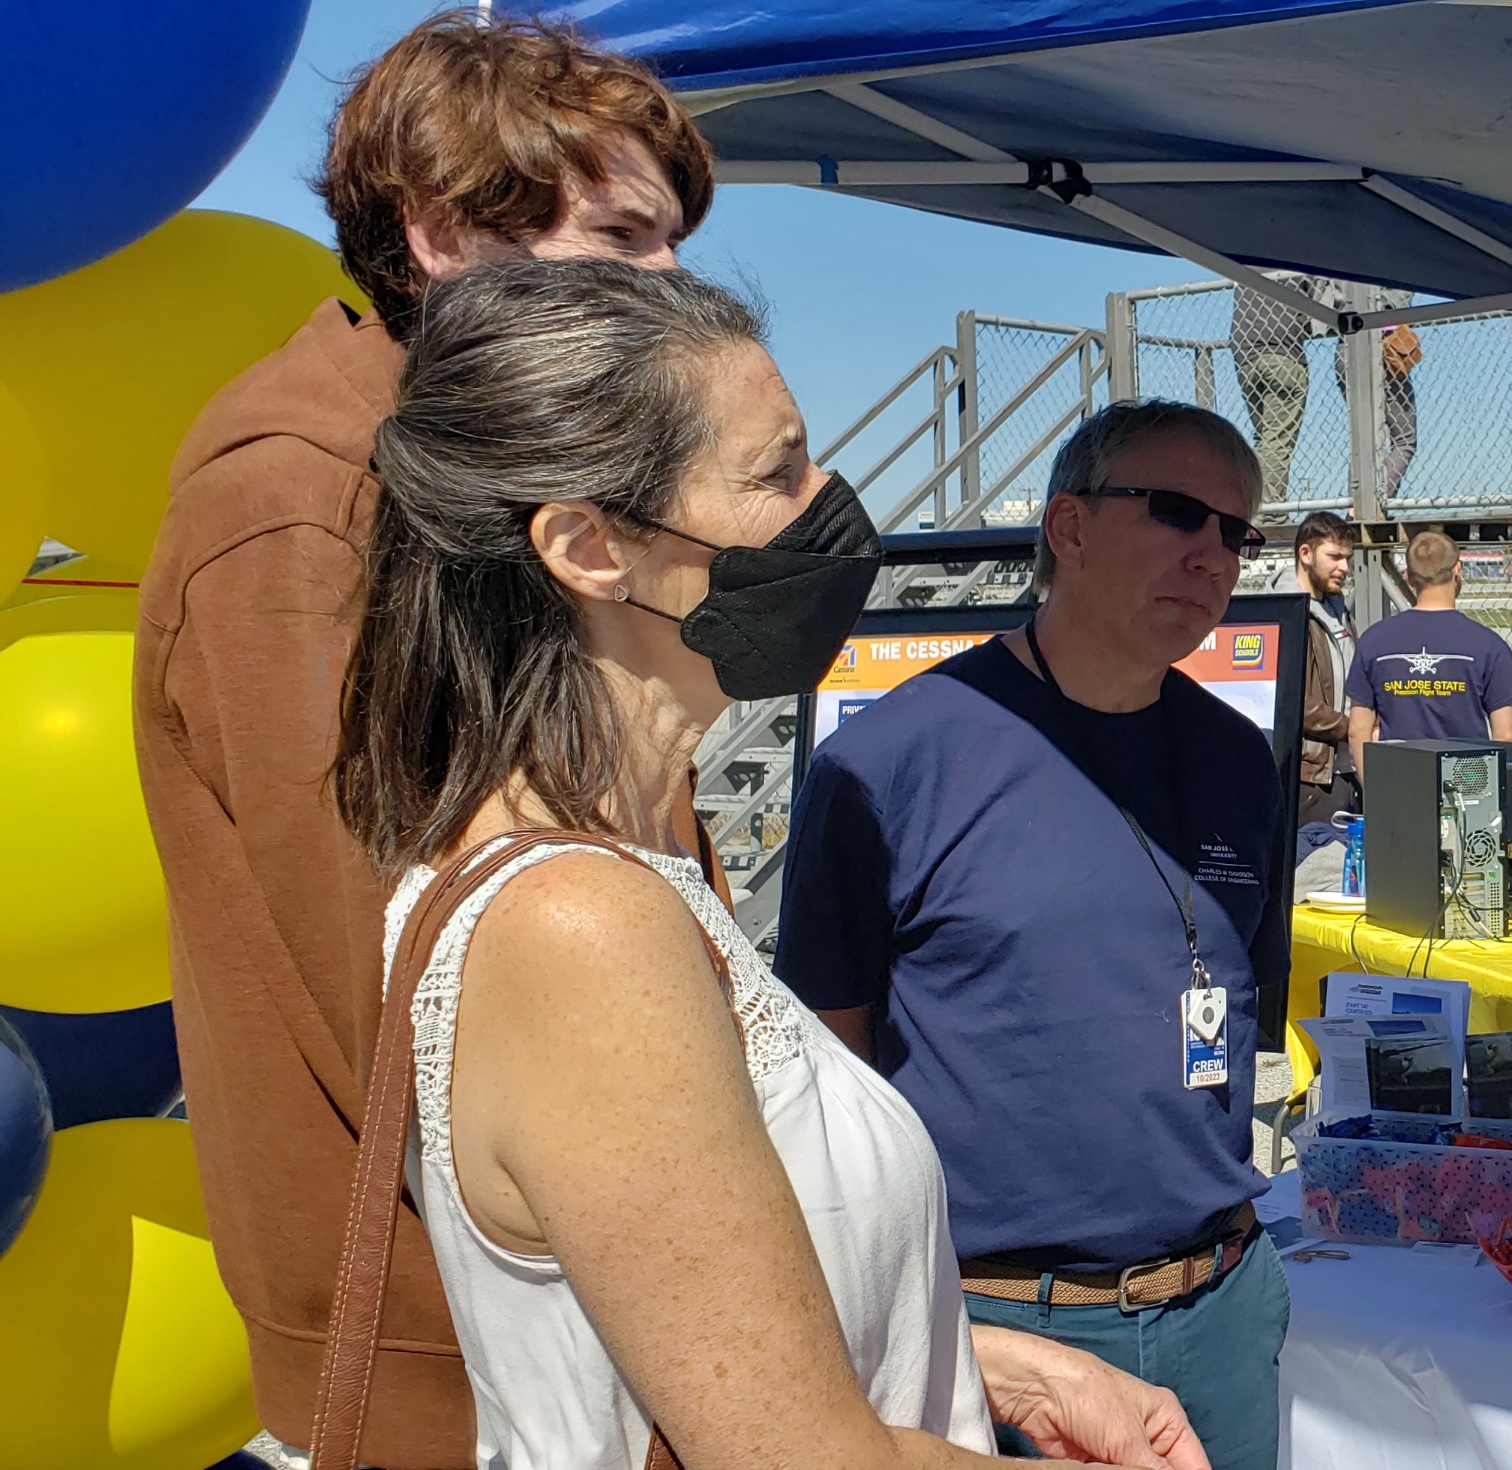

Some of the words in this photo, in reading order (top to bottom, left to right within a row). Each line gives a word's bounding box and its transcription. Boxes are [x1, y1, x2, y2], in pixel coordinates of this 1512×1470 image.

[1235, 634, 1262, 649] KING
[869, 641, 902, 661] THE
[833, 665, 855, 674] Cessna
[1383, 680, 1402, 692] SAN
[1404, 680, 1432, 690] JOSE
[1433, 680, 1466, 692] STATE
[1436, 689, 1452, 697] Team
[1193, 1058, 1224, 1073] CREW
